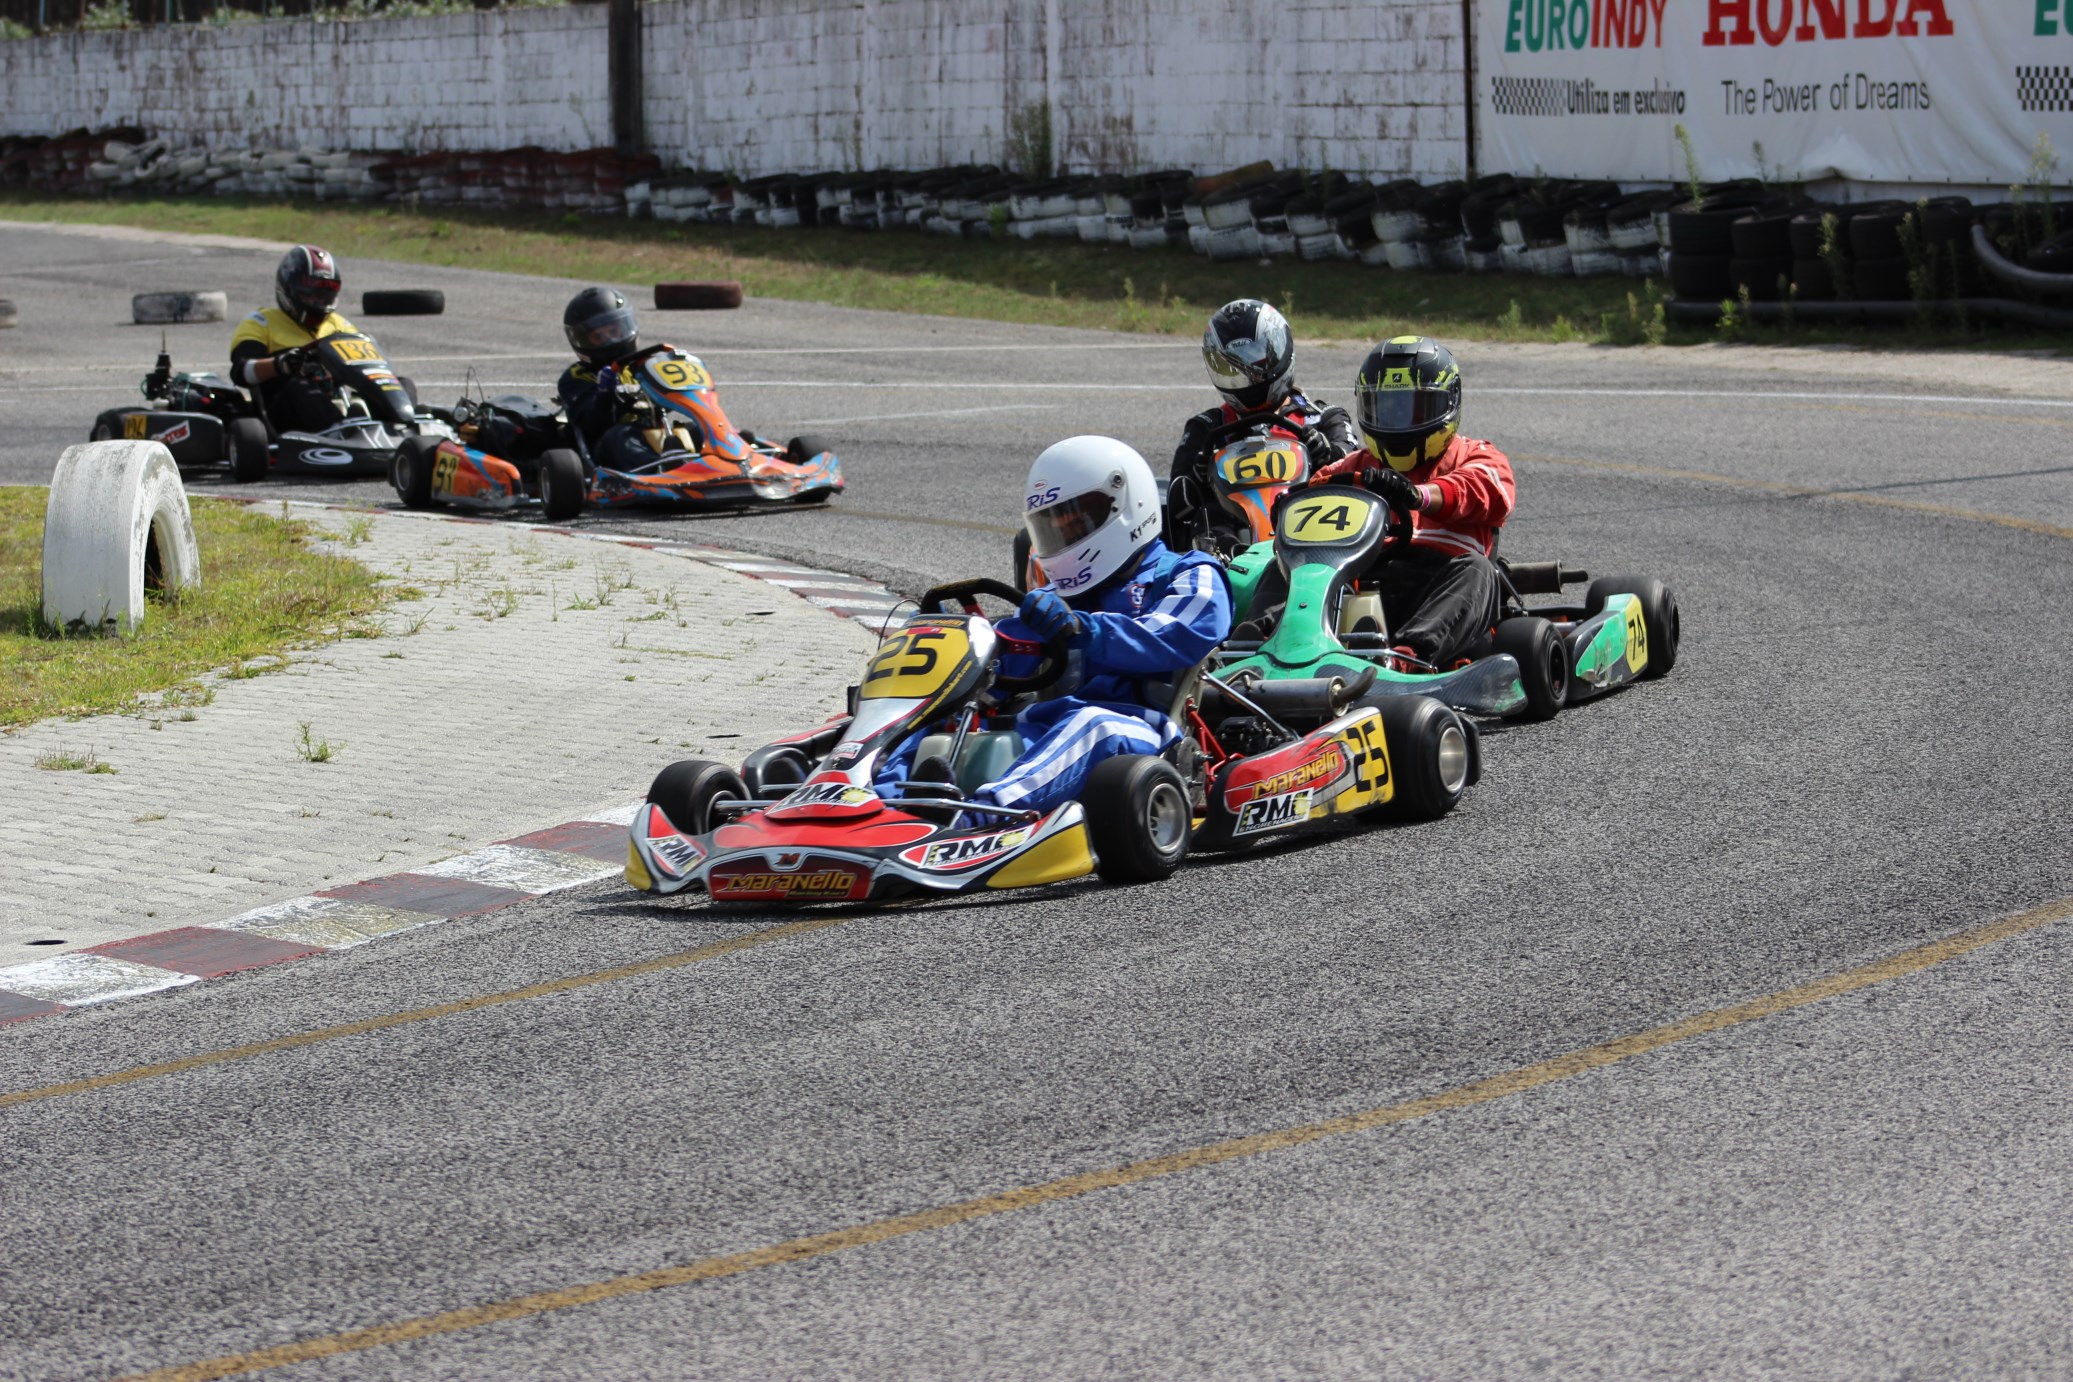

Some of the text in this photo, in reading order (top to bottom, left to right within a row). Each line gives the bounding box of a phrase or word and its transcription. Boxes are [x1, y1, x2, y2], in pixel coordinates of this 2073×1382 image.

[1702, 0, 1954, 47] HONDA
[1567, 77, 1686, 116] Utiliza em exclusivo
[1720, 73, 1930, 115] The Power of Dreams
[661, 363, 705, 385] 93
[1233, 451, 1287, 481] 60
[1293, 505, 1351, 533] 74
[866, 633, 946, 684] 25
[1628, 613, 1646, 662] 74
[1346, 720, 1389, 793] 25
